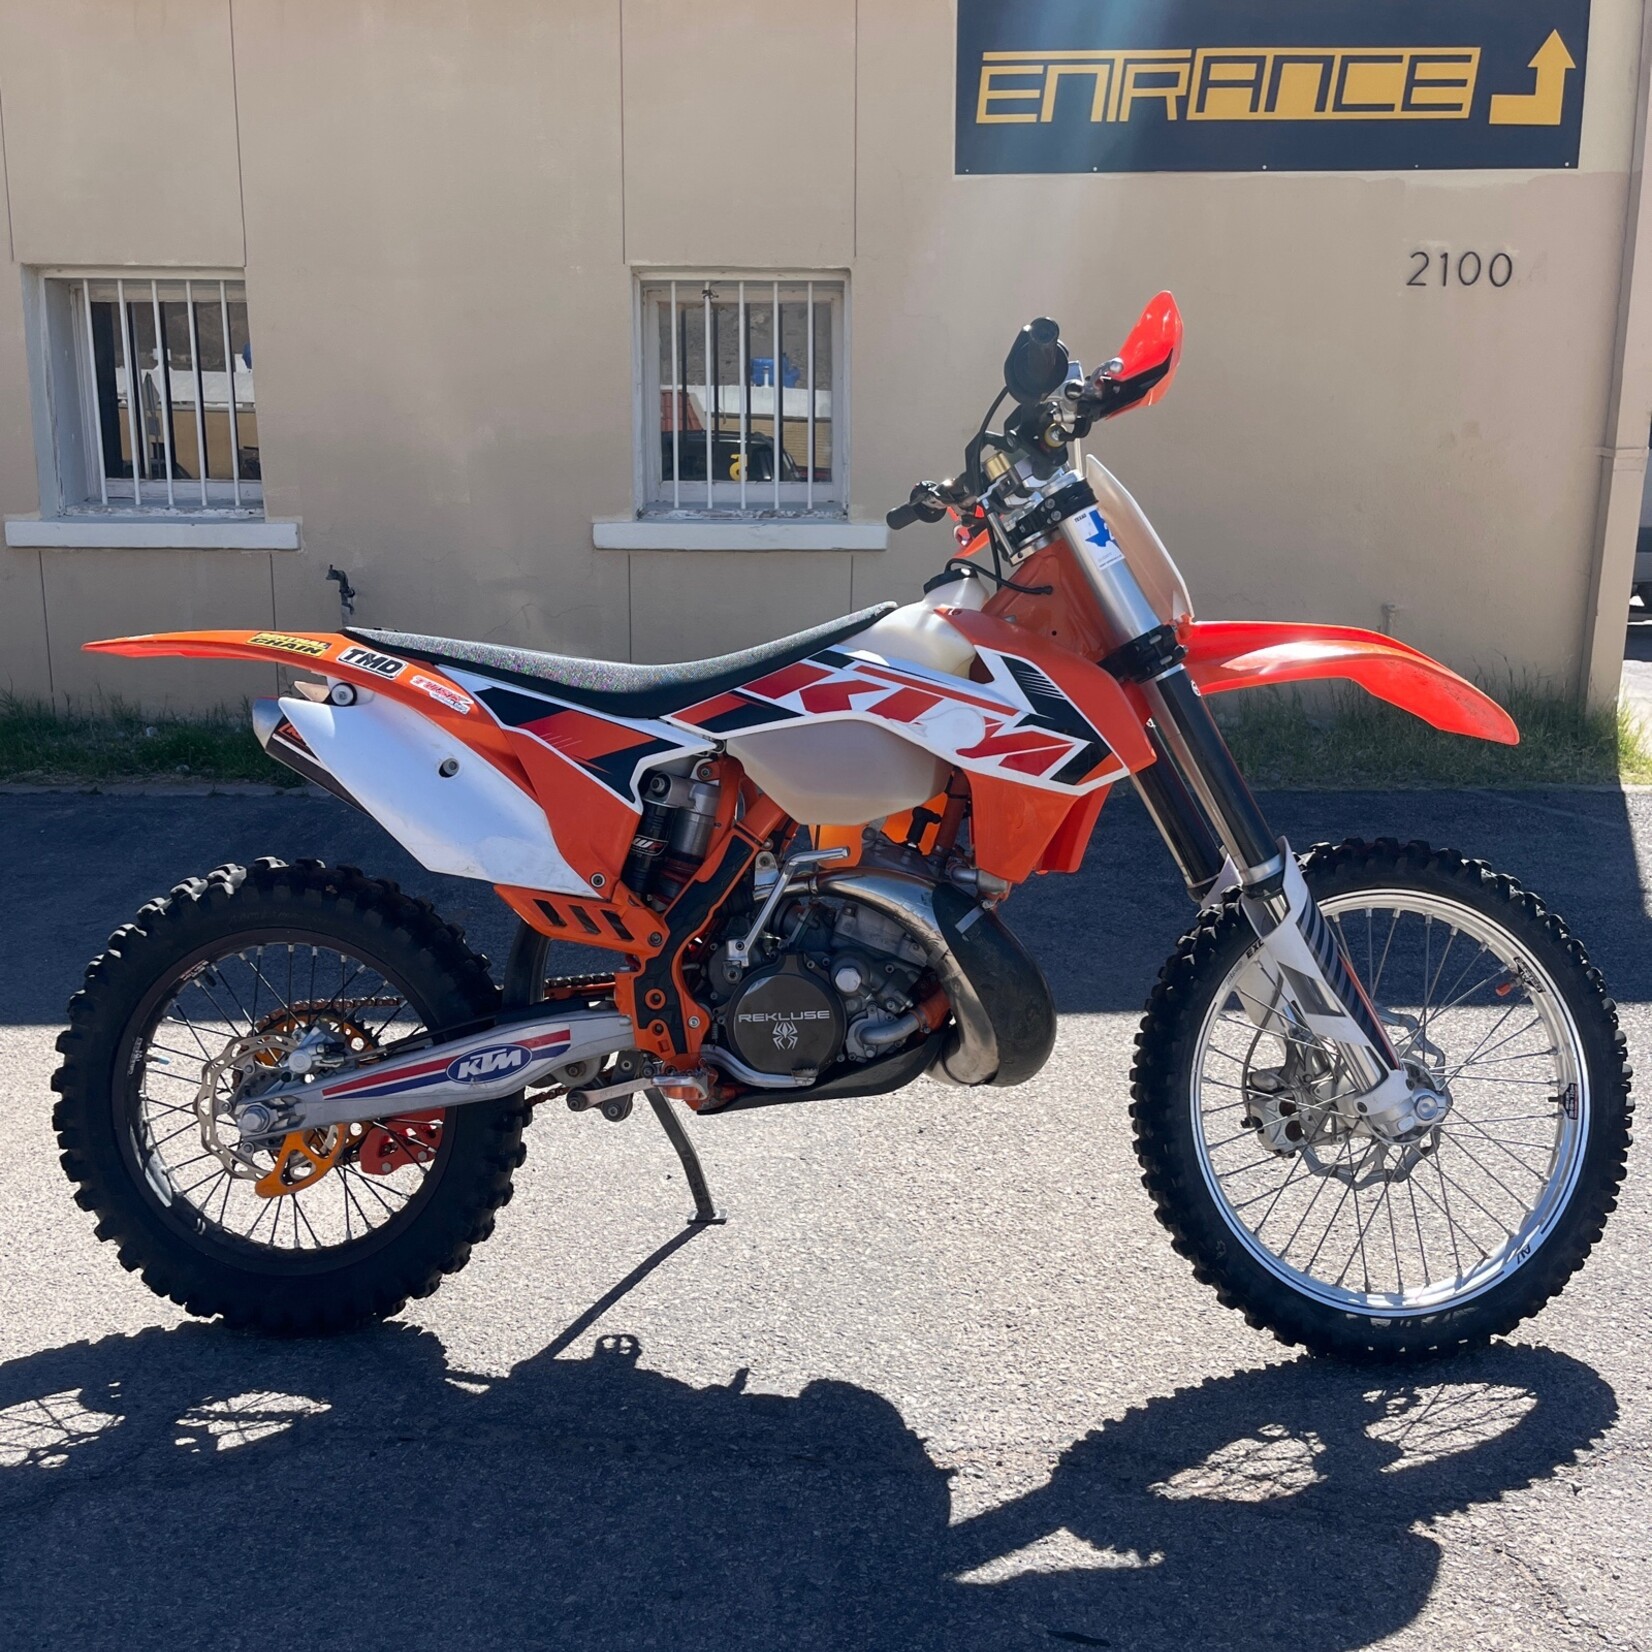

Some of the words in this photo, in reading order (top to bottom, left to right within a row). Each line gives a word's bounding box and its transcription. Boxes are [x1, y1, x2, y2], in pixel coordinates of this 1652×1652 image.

[976, 47, 1481, 123] ENTRANCE
[1406, 251, 1513, 287] 2100
[250, 638, 323, 655] CHAIN
[344, 648, 404, 675] TMD
[738, 1010, 831, 1023] REKLUSE
[457, 1048, 523, 1080] KTM
